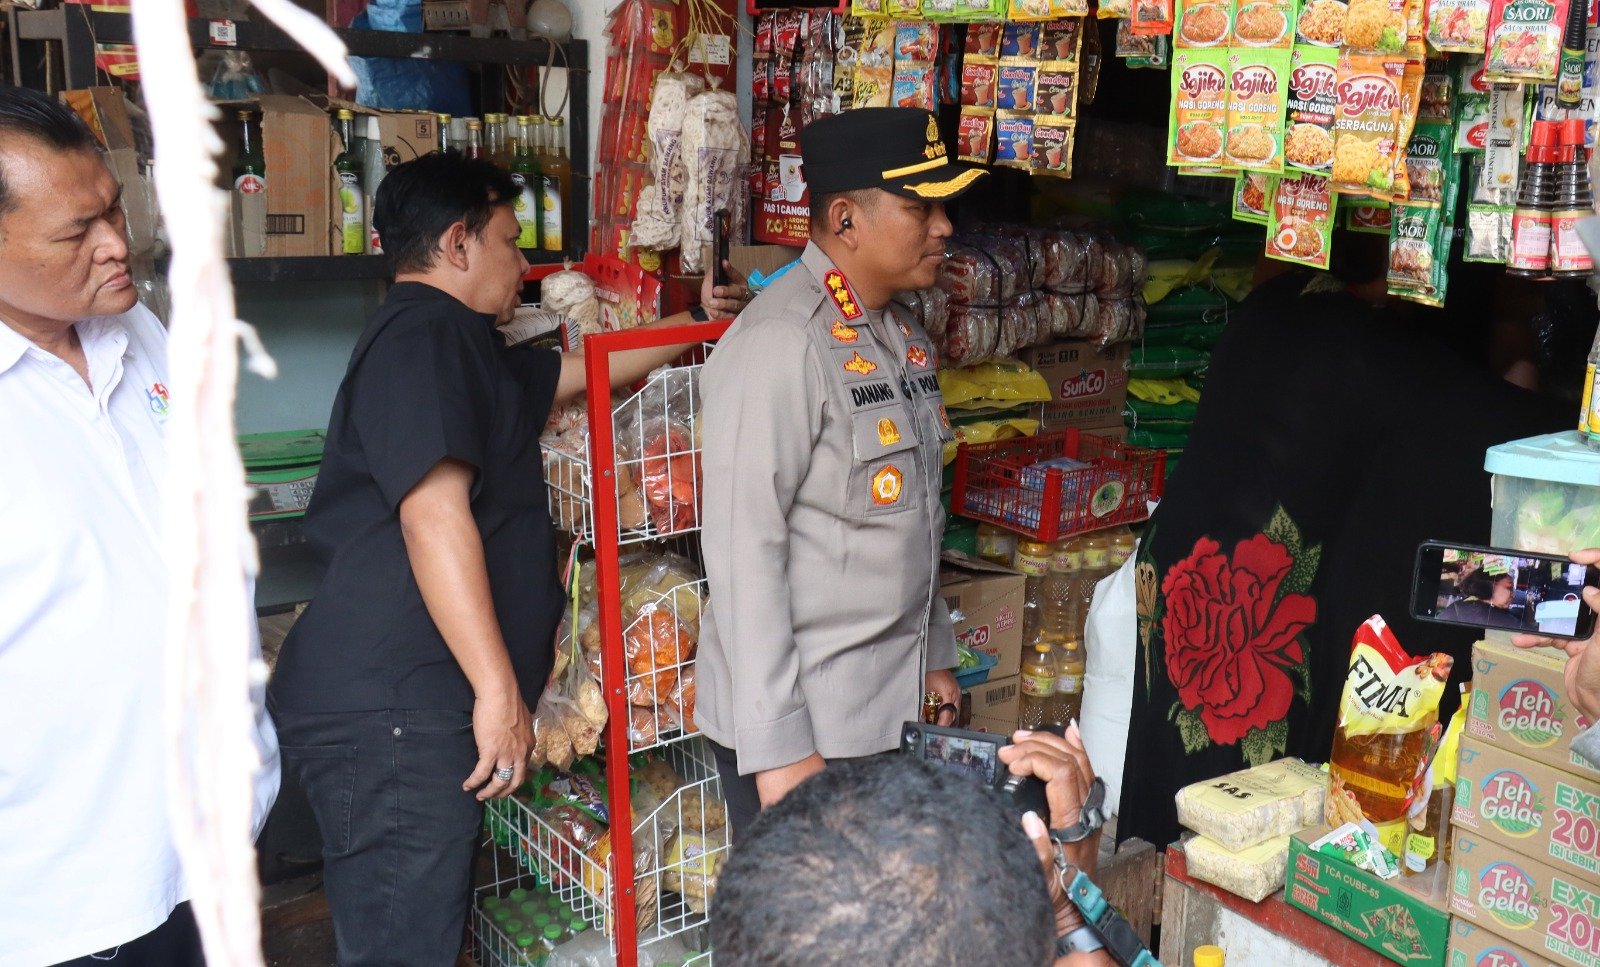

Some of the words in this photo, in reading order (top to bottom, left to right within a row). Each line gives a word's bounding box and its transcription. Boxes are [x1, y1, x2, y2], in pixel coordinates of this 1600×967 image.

[1507, 7, 1551, 21] SAORI
[1564, 62, 1581, 74] SAORI
[1180, 71, 1226, 99] Sajiku
[1230, 71, 1278, 100] Sajiku
[1179, 100, 1196, 110] NASI
[1198, 100, 1225, 110] GORENG
[1228, 101, 1246, 112] NASI
[1248, 103, 1277, 113] GORENG
[1287, 99, 1307, 109] NASI
[1308, 103, 1336, 115] GOREN
[1337, 82, 1400, 117] Sajiku
[1491, 93, 1499, 131] PANTENE
[421, 125, 427, 133] 5
[1335, 119, 1395, 133] SERBAGUNA
[384, 153, 399, 166] BC
[706, 155, 717, 184] BAWANG
[1487, 149, 1496, 186] PANTENE
[763, 202, 776, 213] PAS
[780, 205, 810, 217] CANGKI
[1277, 195, 1295, 206] NASI
[1296, 198, 1328, 212] GORENG
[788, 217, 809, 225] AROMA
[1397, 225, 1425, 238] SAORI
[851, 383, 895, 407] DANANG
[1062, 373, 1102, 397] SunCo
[1346, 654, 1411, 718] FIMA
[1511, 686, 1551, 714] Teh
[1498, 707, 1563, 737] Gelas
[1212, 783, 1253, 799] SAS
[1493, 776, 1531, 805] Teh
[1555, 782, 1600, 820] EXT
[1480, 796, 1543, 828] Gelas
[1550, 843, 1564, 857] ISI
[1565, 848, 1597, 872] LEBIH
[1325, 864, 1342, 881] TCA
[1343, 874, 1380, 899] CUBE-65
[1491, 868, 1529, 898] Teh
[1478, 887, 1539, 921] Gelas
[1552, 877, 1600, 918] EXT
[1546, 937, 1560, 951] ISI
[1561, 941, 1594, 966] LEBIH
